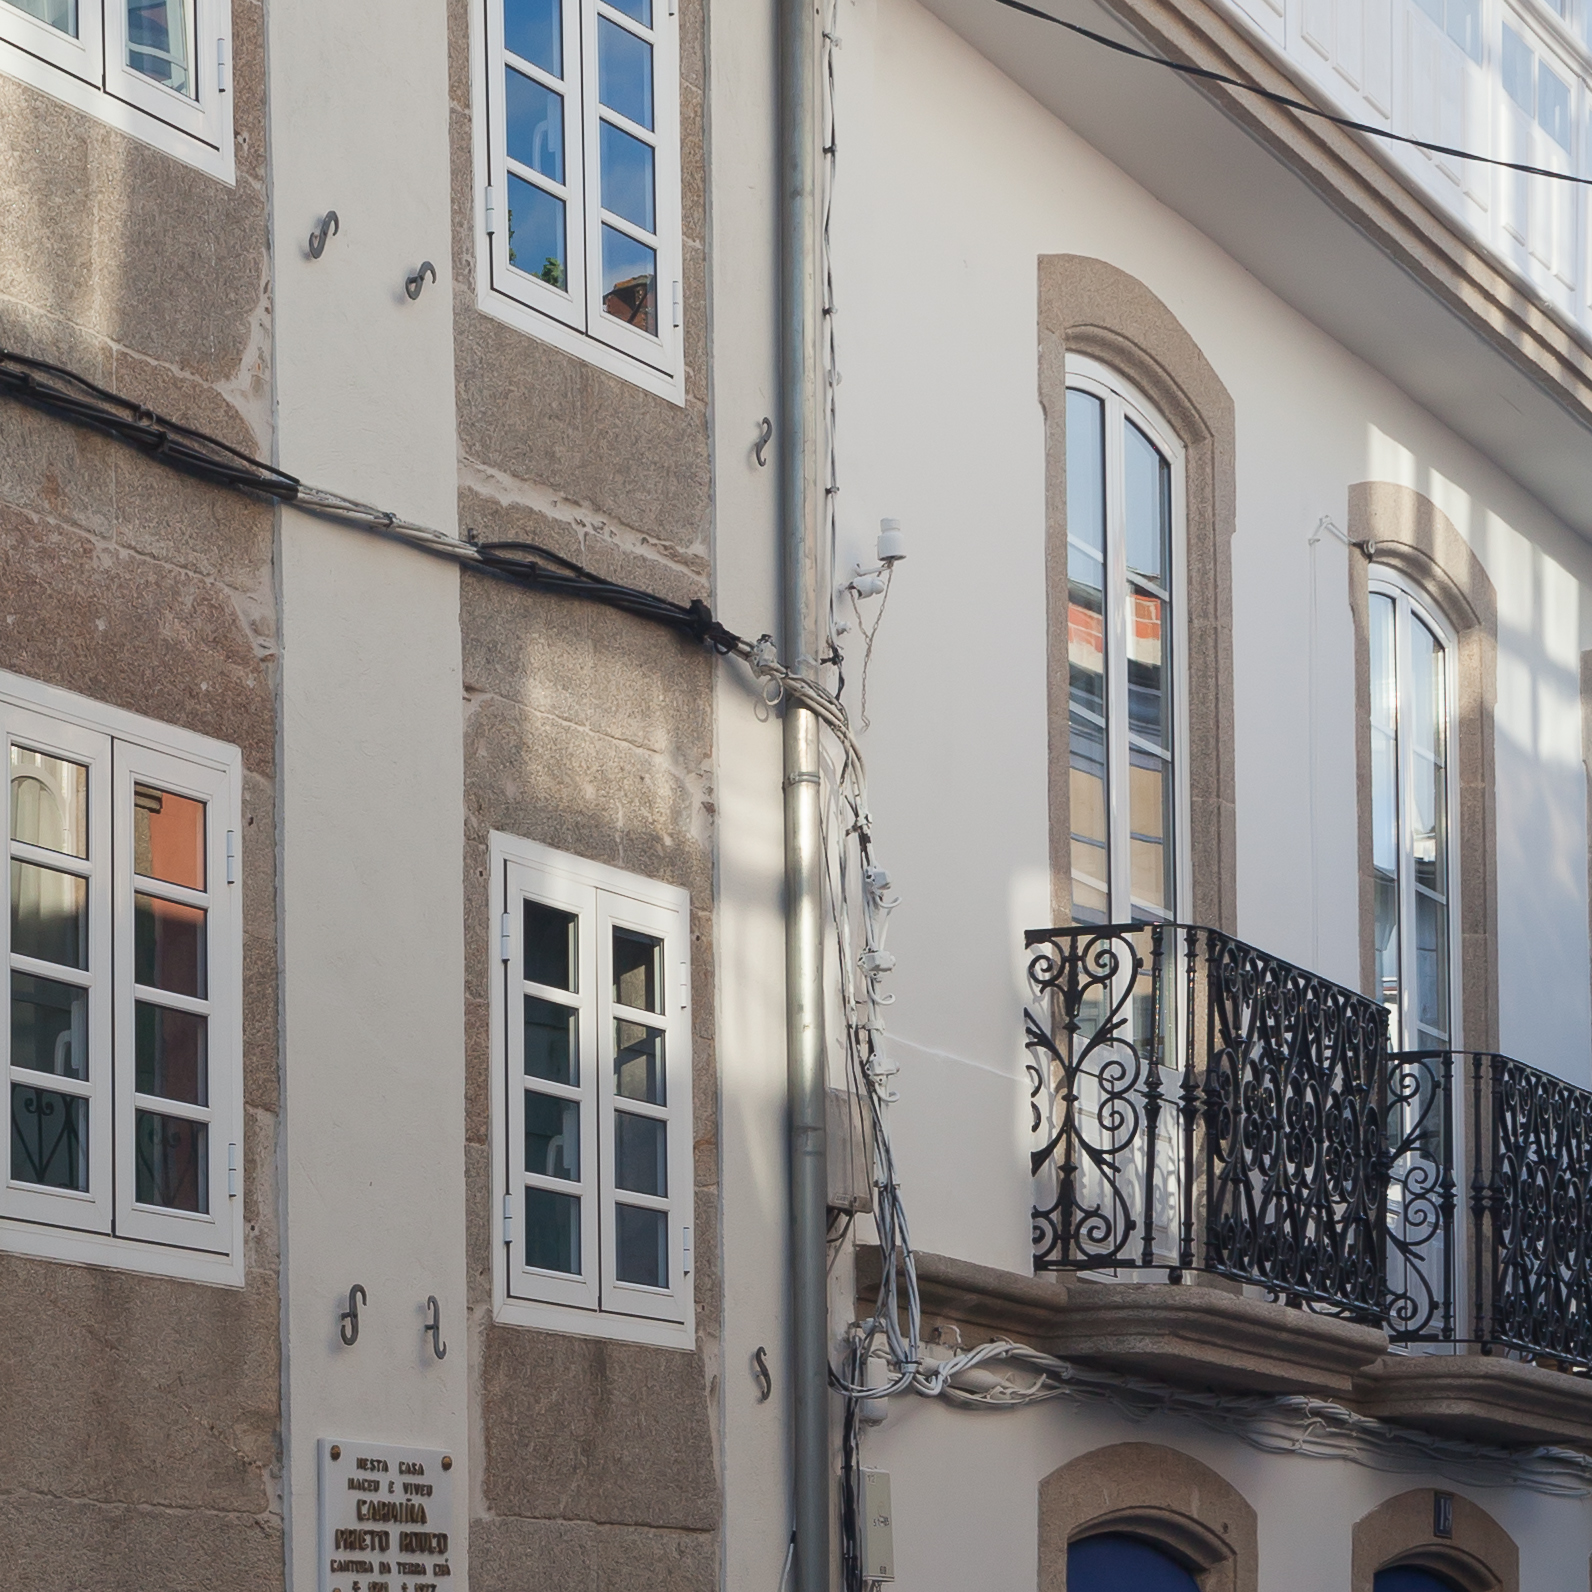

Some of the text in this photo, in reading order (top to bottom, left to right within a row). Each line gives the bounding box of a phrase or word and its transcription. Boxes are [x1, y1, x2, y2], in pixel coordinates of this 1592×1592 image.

[356, 1457, 424, 1476] NESTA CASA
[347, 1477, 433, 1497] NACEU E VIVEU
[356, 1497, 428, 1525] CARMIÑA
[1440, 1498, 1452, 1531] 19
[335, 1528, 449, 1555] PRIETO ROUCO
[330, 1558, 374, 1574] CANTORA
[379, 1561, 392, 1575] DA
[396, 1561, 427, 1576] TERRA
